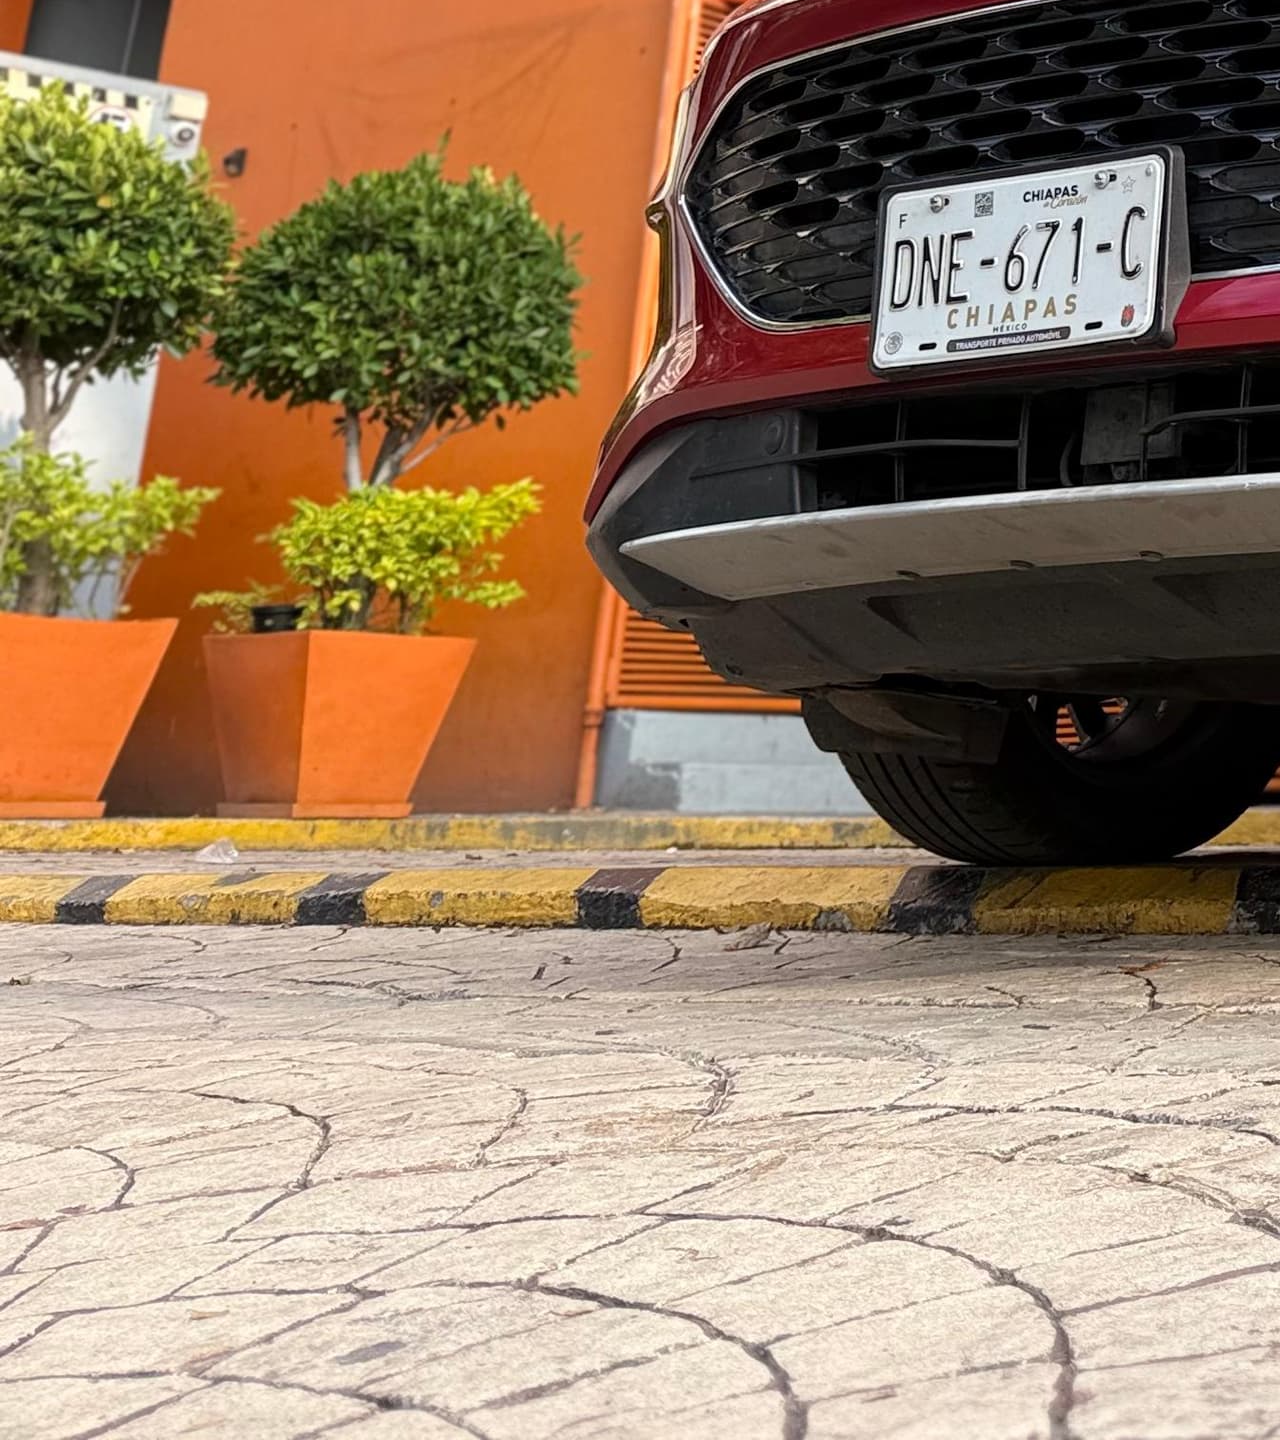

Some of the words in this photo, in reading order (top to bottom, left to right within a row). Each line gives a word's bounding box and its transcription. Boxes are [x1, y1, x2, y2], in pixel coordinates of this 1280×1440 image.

[1023, 185, 1079, 203] CHIAPAS
[899, 213, 908, 229] F
[890, 207, 1148, 311] DNE-671-C
[947, 294, 1078, 329] CHIAPAS
